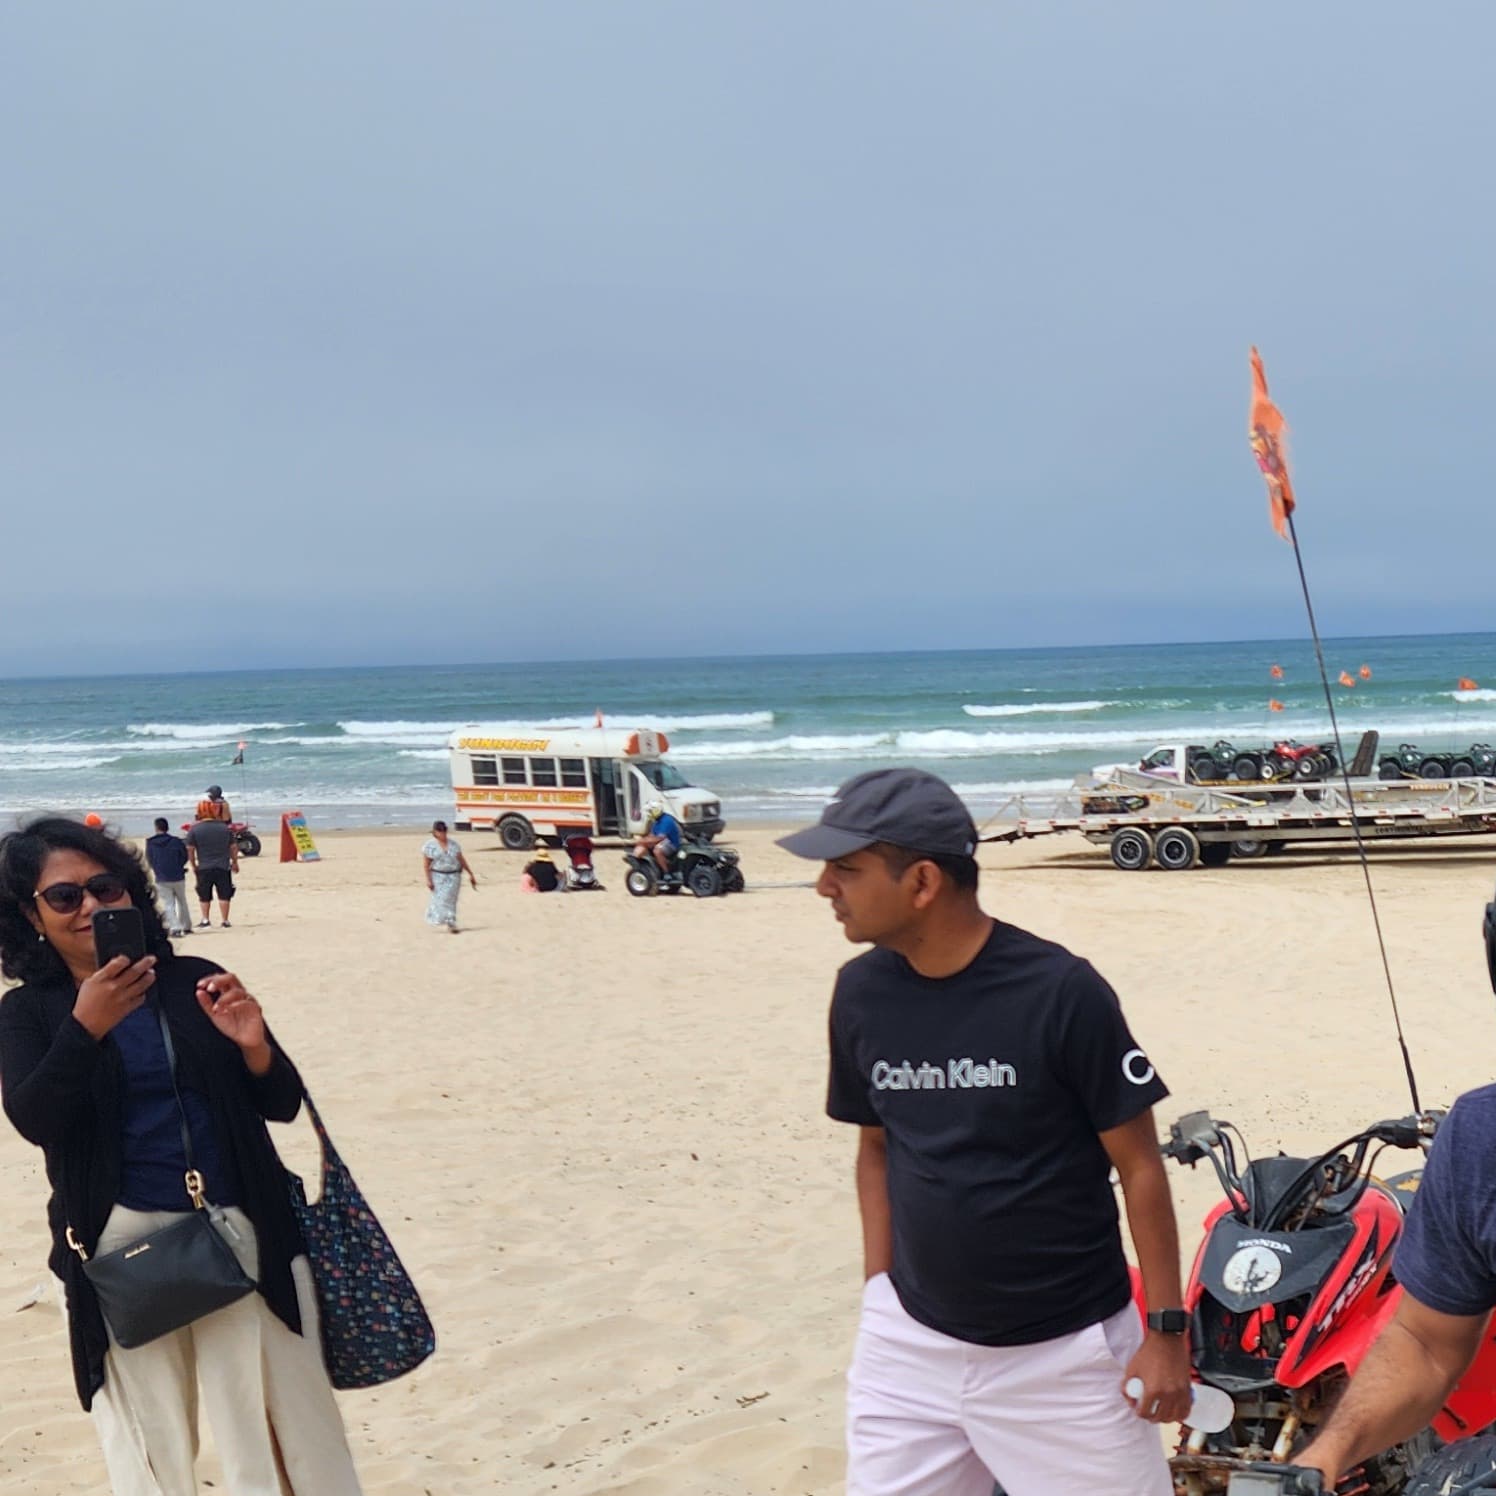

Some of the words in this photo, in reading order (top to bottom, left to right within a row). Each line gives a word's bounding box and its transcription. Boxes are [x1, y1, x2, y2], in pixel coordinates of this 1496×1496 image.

[871, 1059, 946, 1090] Calvin
[948, 1057, 1017, 1088] Klein
[1236, 1238, 1293, 1255] HONDA
